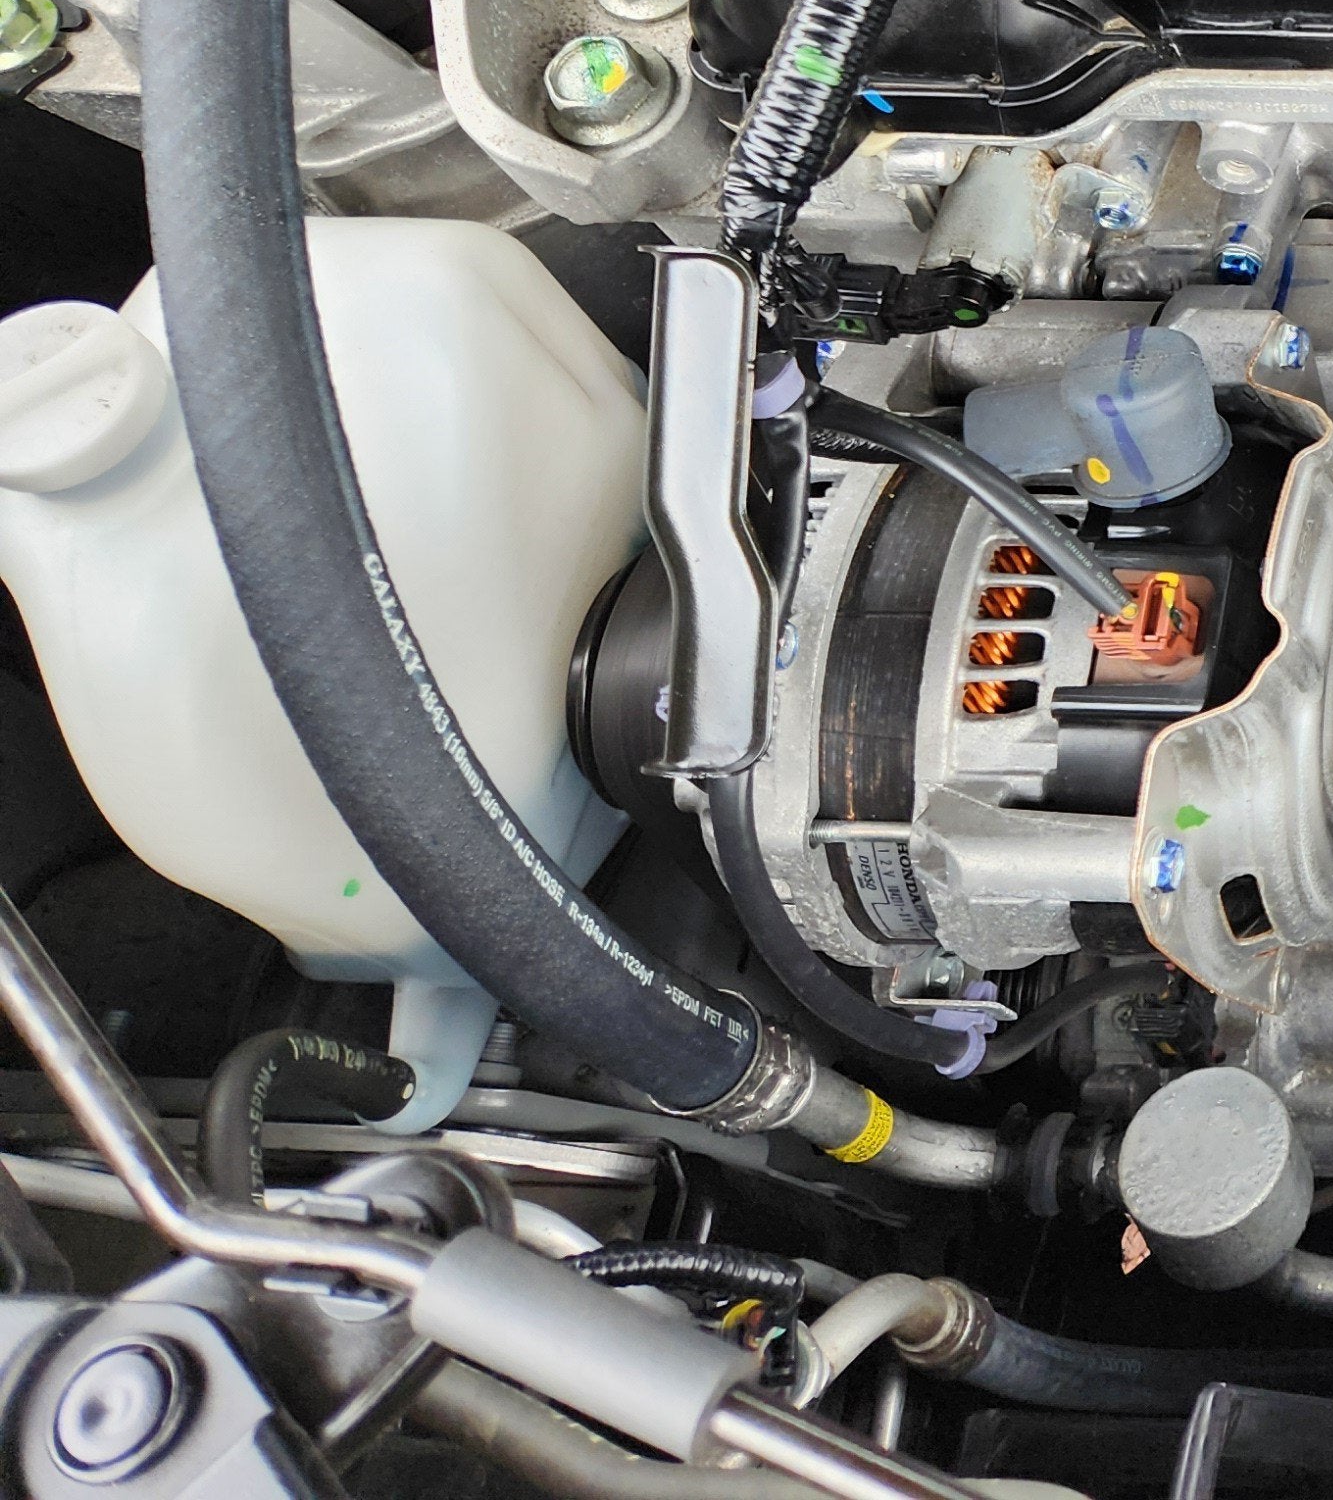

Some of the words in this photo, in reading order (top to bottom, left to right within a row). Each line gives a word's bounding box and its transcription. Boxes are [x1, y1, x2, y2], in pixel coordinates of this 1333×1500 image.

[1041, 516, 1063, 538] PVC
[1063, 538, 1094, 569] WIRING
[363, 553, 425, 676] GALAXY
[498, 820, 520, 843] ID
[701, 1005, 728, 1031] PET
[857, 854, 877, 891] DENSO
[897, 842, 921, 905] HONDA
